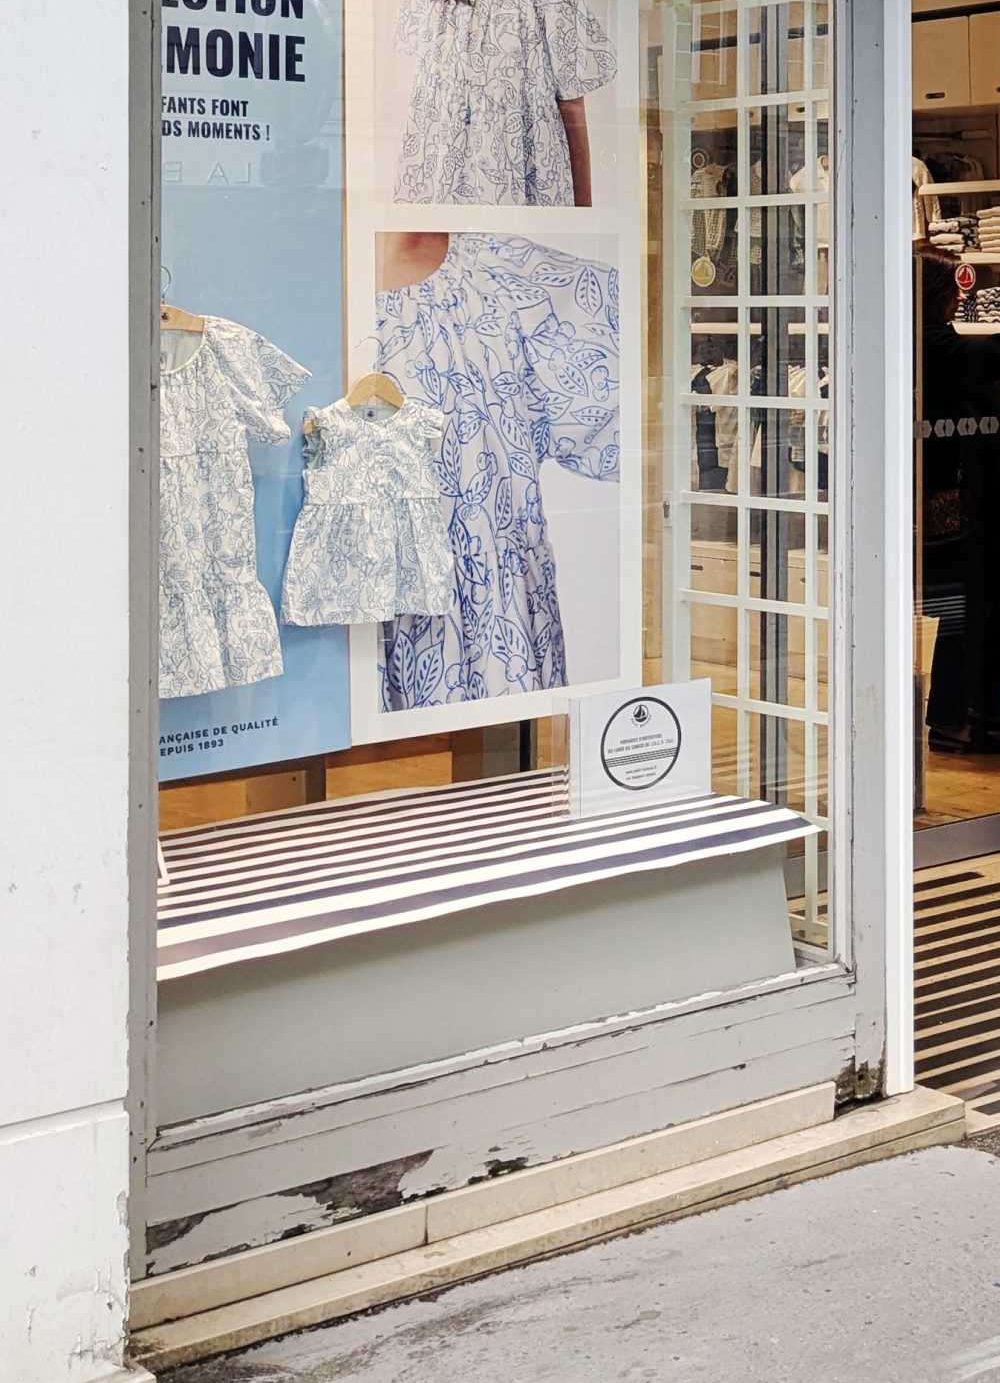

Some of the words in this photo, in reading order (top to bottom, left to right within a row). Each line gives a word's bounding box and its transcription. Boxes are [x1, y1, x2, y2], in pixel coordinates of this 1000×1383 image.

[166, 25, 306, 83] MONIE
[211, 99, 249, 117] FONT
[161, 120, 182, 137] DS
[187, 121, 261, 141] MOMENTS
[159, 729, 209, 745] ANÇAISE
[213, 726, 228, 736] DE
[231, 716, 279, 735] QUALITÉ
[160, 744, 194, 757] EPUIS
[199, 739, 224, 751] 1893
